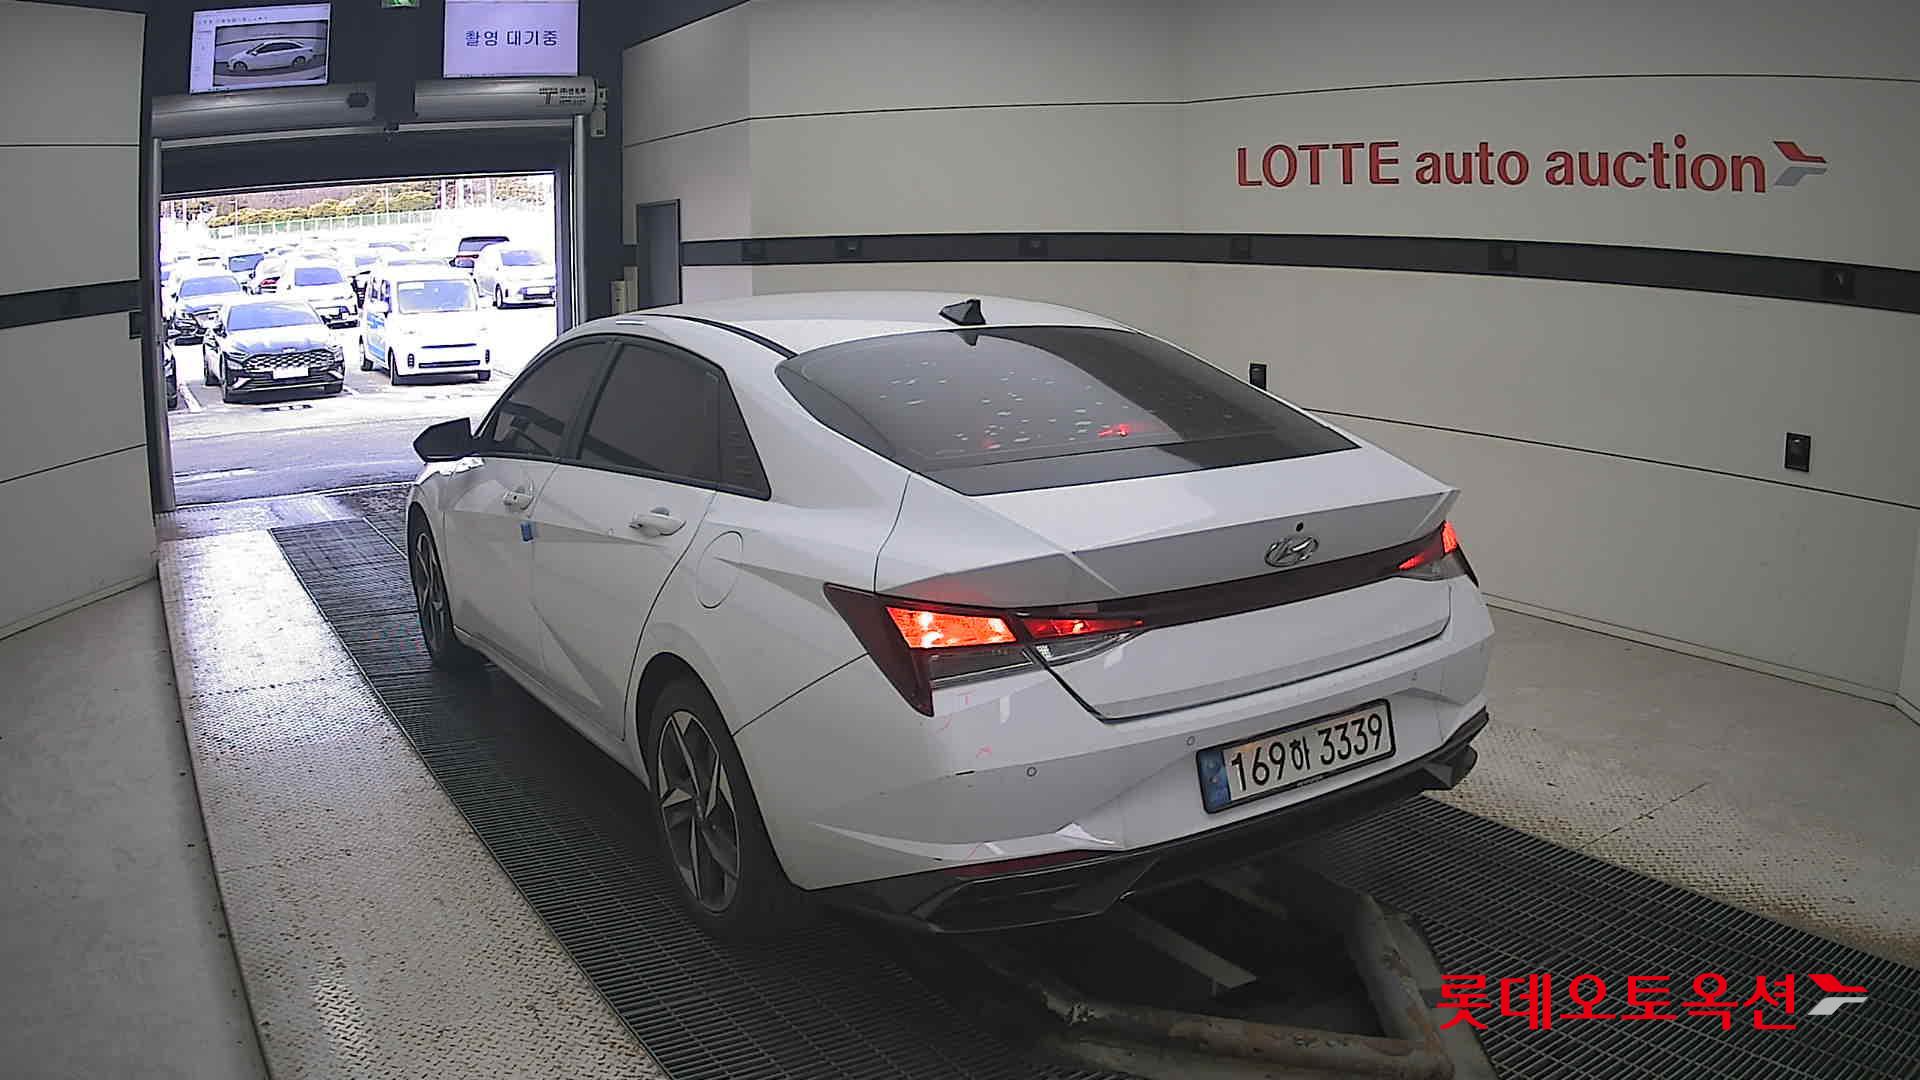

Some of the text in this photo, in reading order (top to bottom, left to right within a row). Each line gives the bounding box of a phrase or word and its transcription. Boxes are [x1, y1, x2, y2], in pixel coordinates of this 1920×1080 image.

[465, 30, 558, 47] 촬영 대기중
[1236, 134, 1766, 193] LOTTE auto auction
[1230, 713, 1383, 791] 169하 3339
